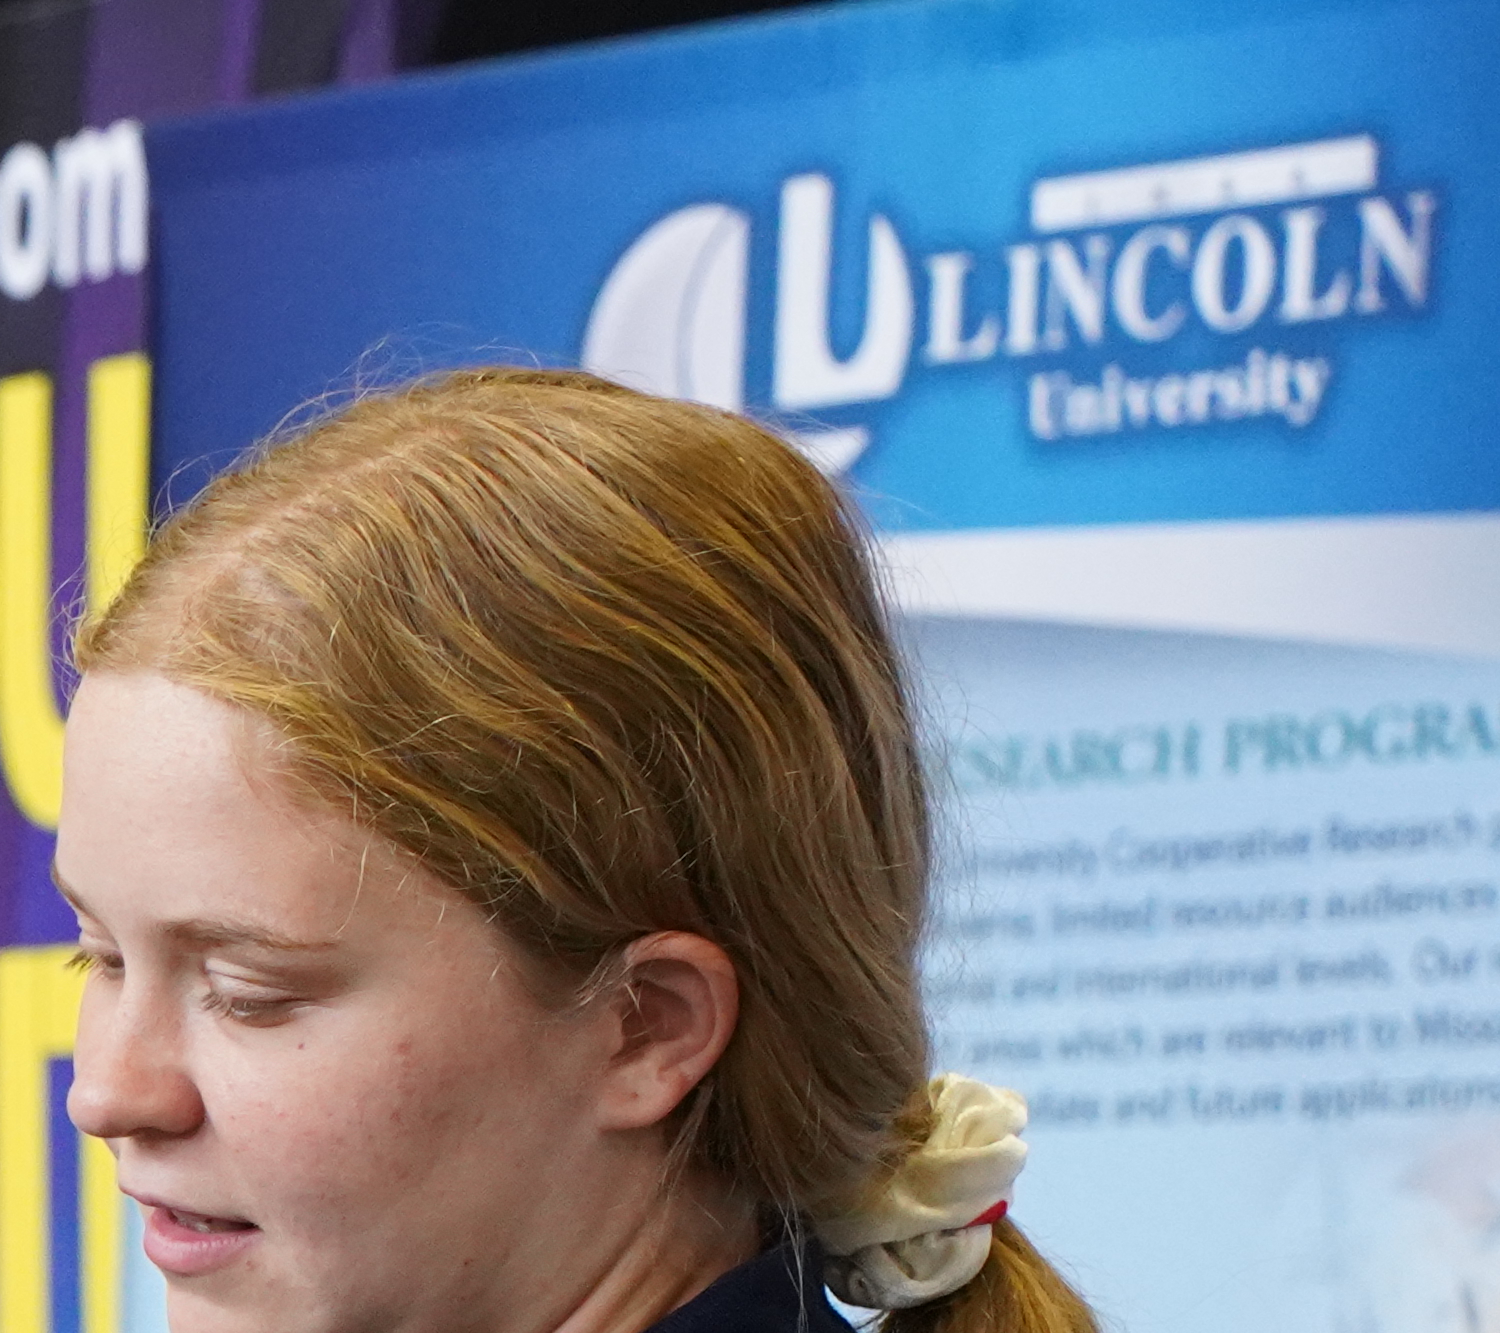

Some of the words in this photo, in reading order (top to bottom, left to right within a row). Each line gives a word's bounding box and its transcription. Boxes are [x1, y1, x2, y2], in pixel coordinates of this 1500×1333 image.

[922, 189, 1436, 367] LINCOLN
[1028, 348, 1330, 441] University
[1412, 936, 1479, 983] Our
